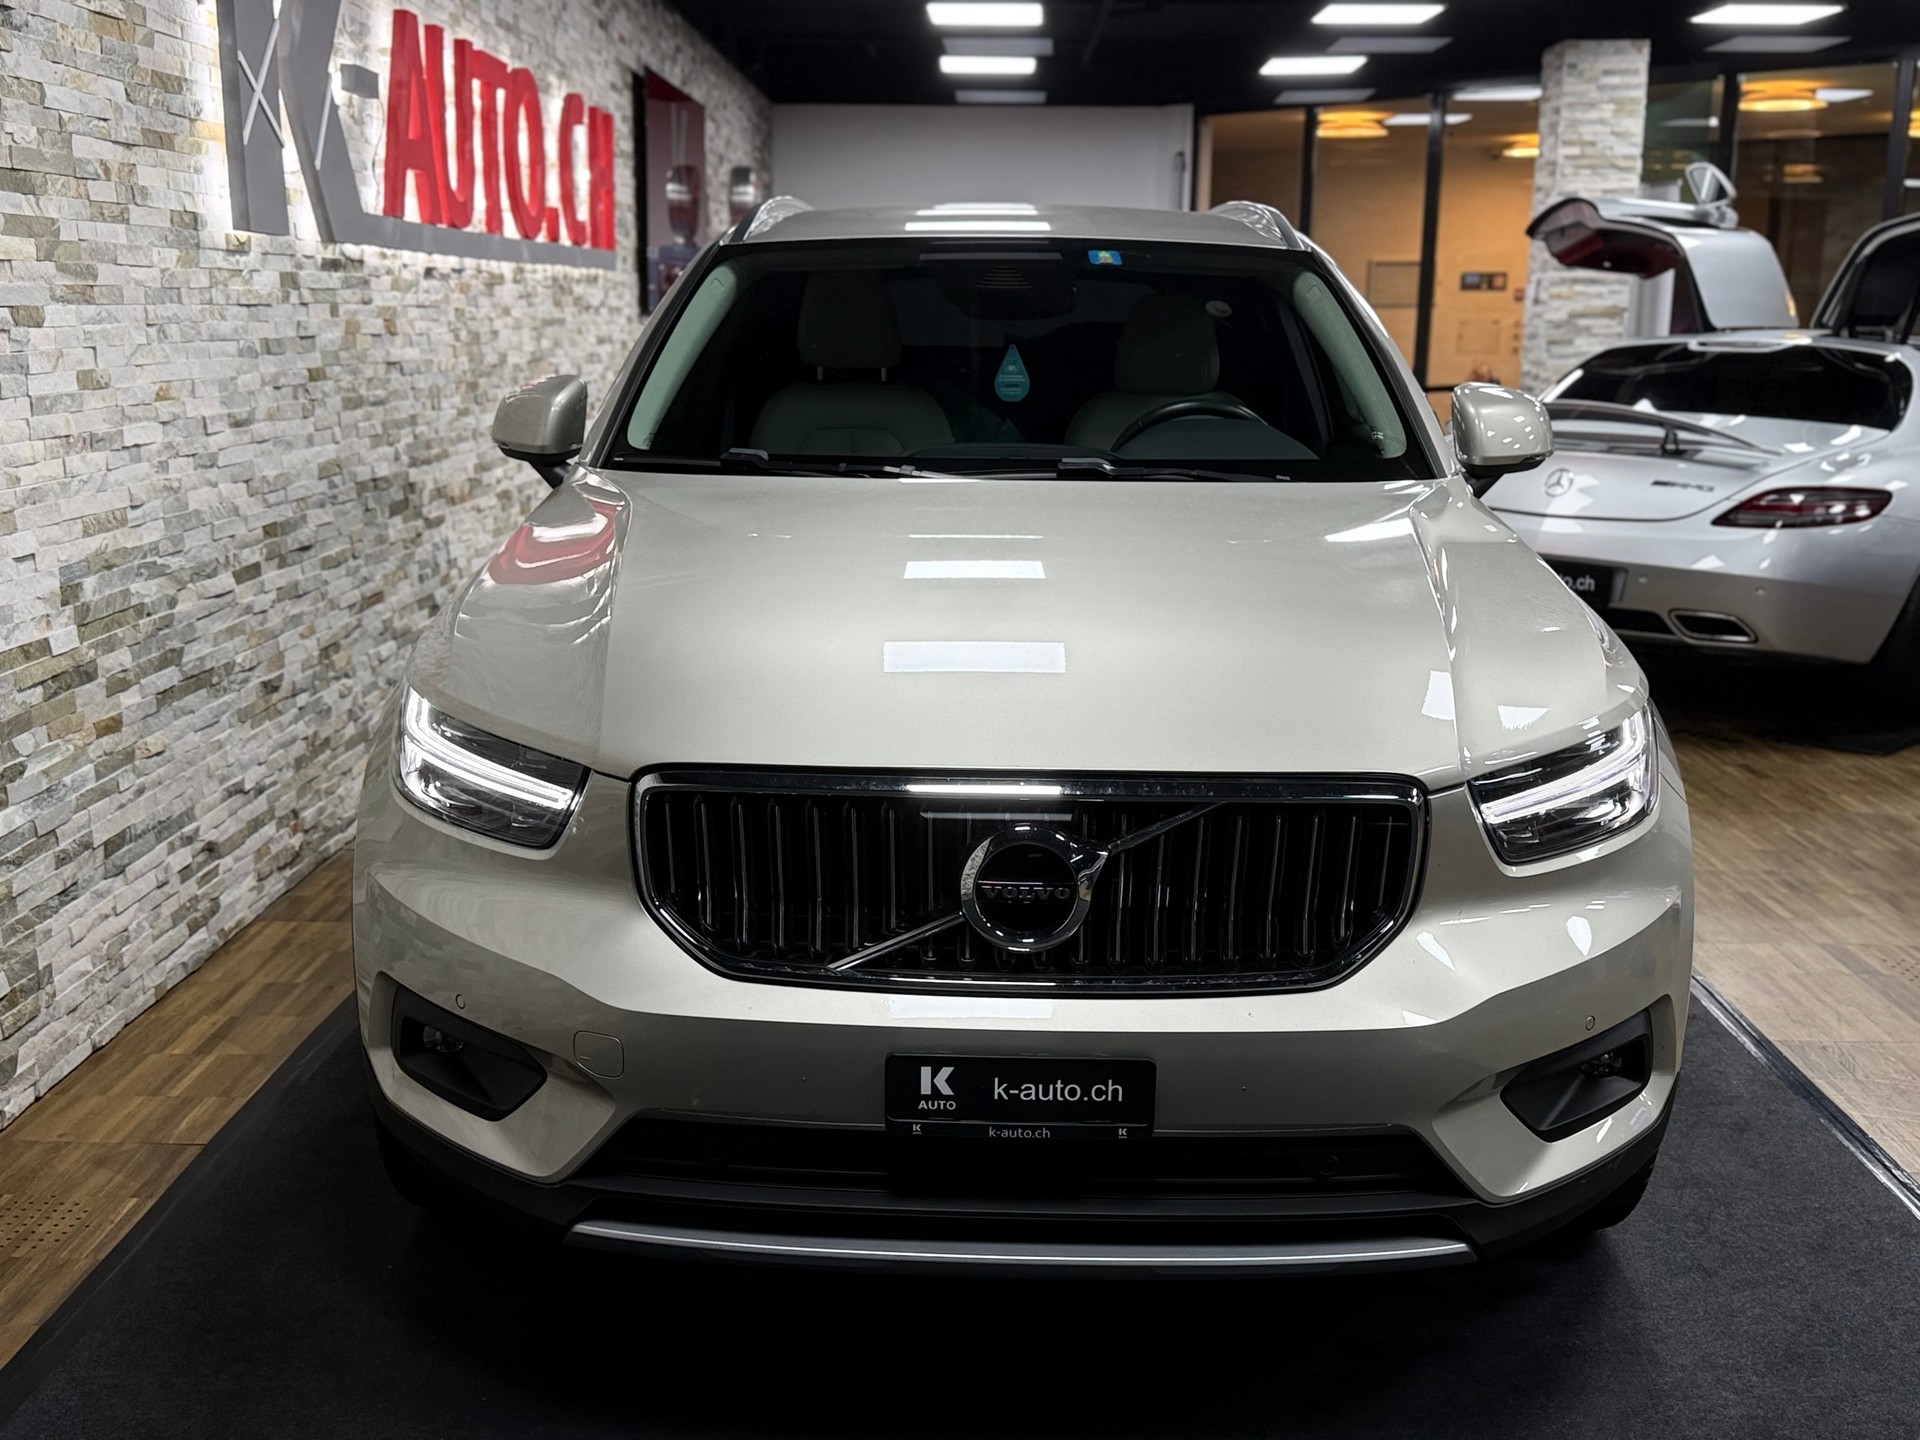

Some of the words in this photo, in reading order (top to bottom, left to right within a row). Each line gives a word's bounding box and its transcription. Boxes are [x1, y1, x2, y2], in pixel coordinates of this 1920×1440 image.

[1560, 573, 1596, 592] o.ch
[980, 885, 1070, 900] VOLVO
[993, 1077, 1123, 1102] k-auto.ch
[918, 1100, 956, 1110] AUTO
[988, 1126, 1051, 1139] k-auto.ch
